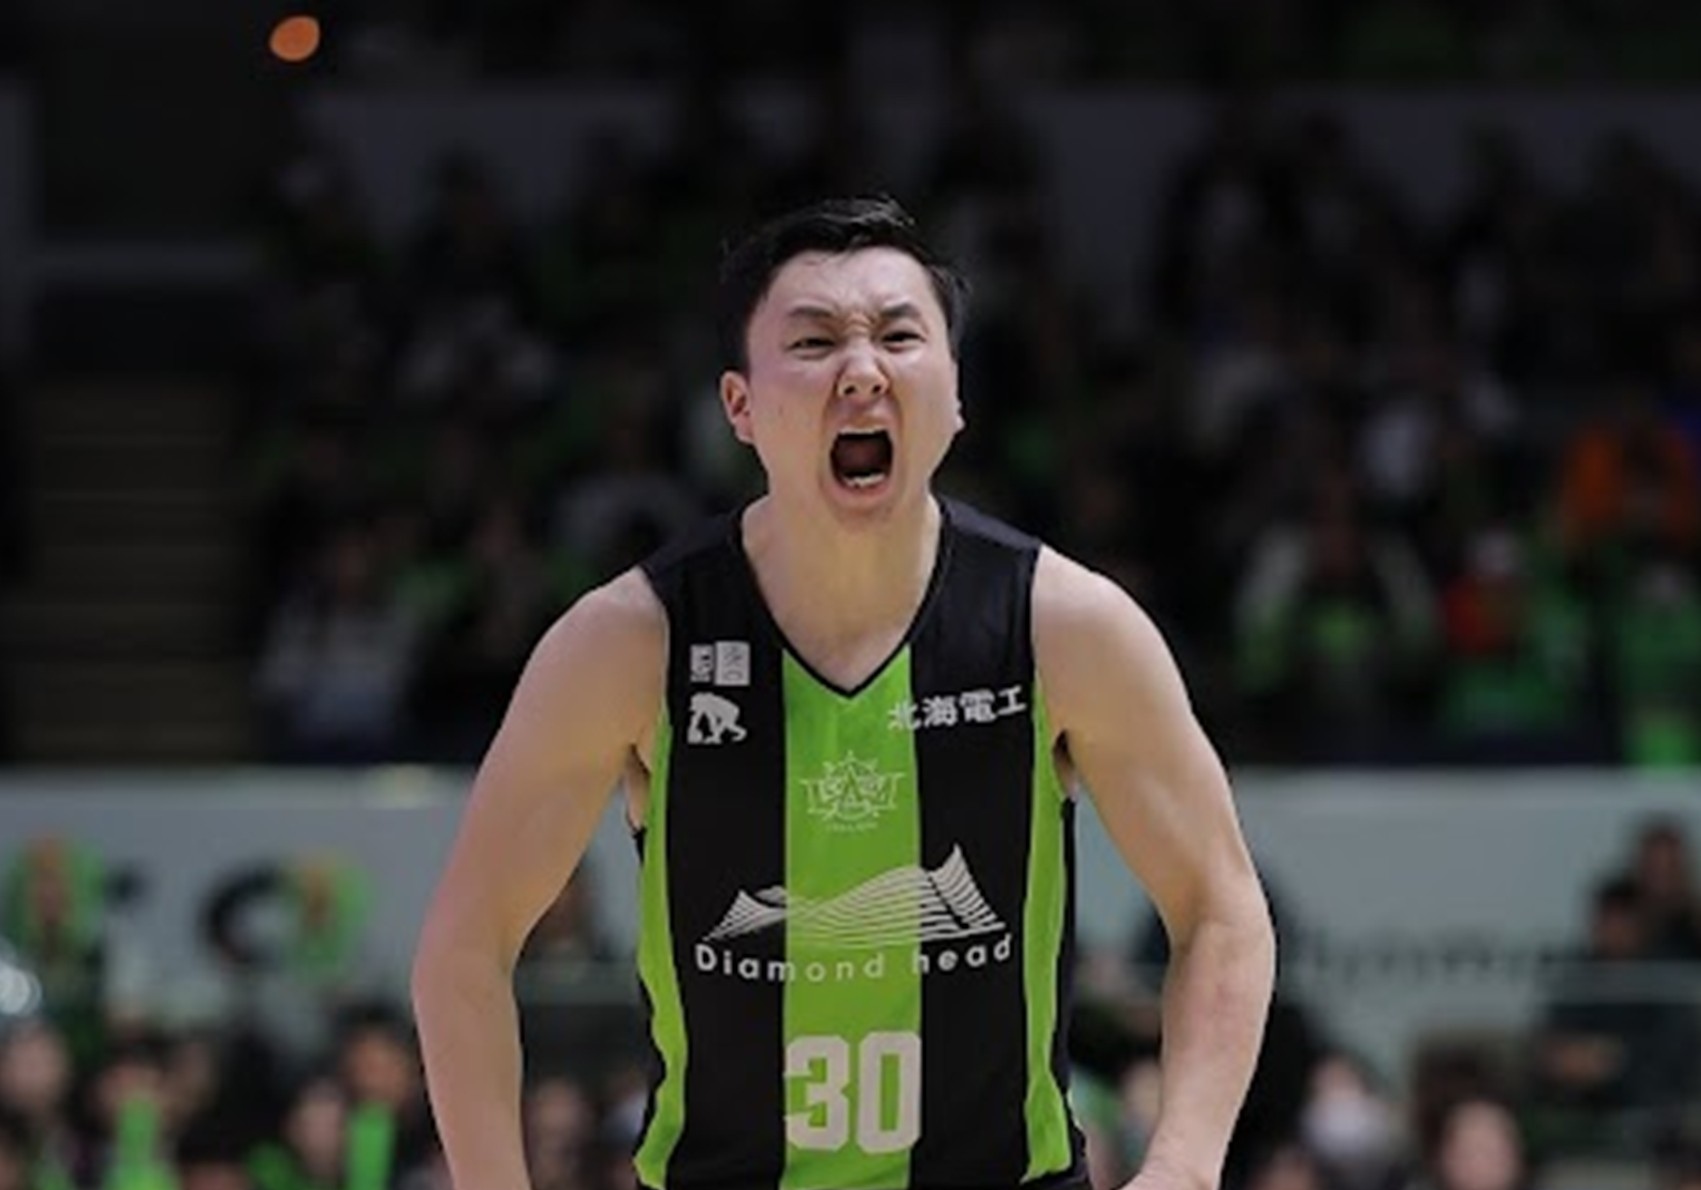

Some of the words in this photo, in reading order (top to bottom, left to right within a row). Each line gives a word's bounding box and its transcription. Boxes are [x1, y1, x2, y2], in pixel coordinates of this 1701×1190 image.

[887, 684, 1026, 729] 北海電工
[695, 944, 884, 982] Diamond
[912, 933, 1013, 973] head
[785, 1031, 922, 1154] 30
